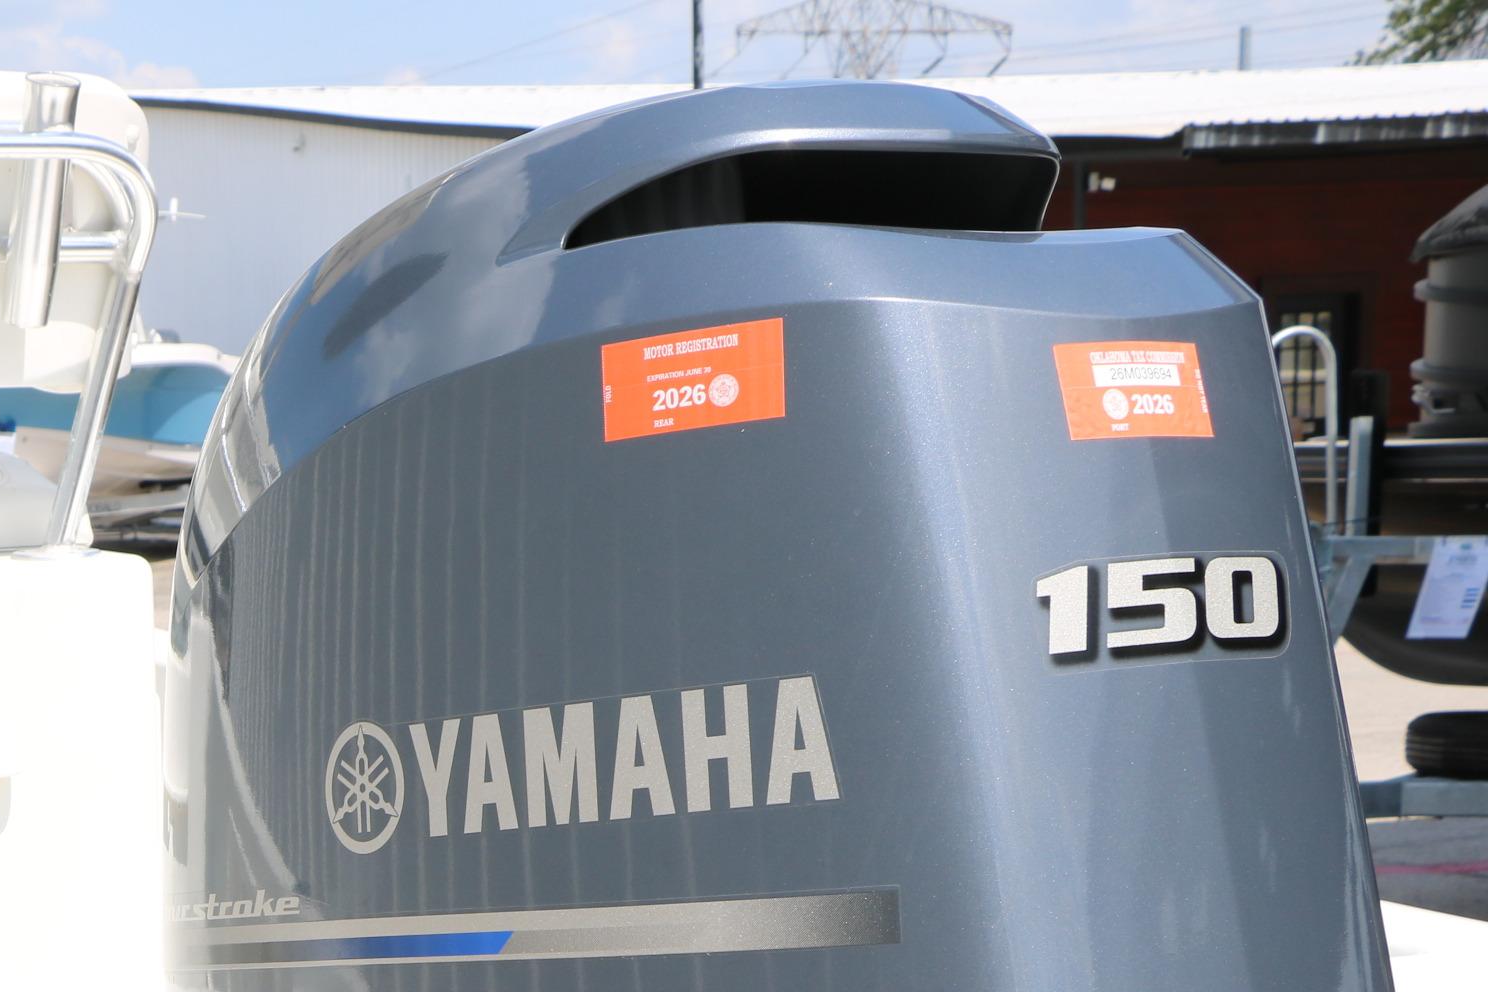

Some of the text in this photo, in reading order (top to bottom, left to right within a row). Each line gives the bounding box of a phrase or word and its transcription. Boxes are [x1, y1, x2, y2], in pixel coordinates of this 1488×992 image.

[643, 333, 739, 360] MOTOR REGISTRATION
[646, 370, 684, 383] EXPIRATION
[685, 367, 702, 377] JUNE
[652, 384, 706, 411] 2026
[1131, 394, 1174, 415] 2026
[653, 417, 674, 428] REAR
[1036, 556, 1280, 655] 150
[408, 675, 840, 838] YAMAHA
